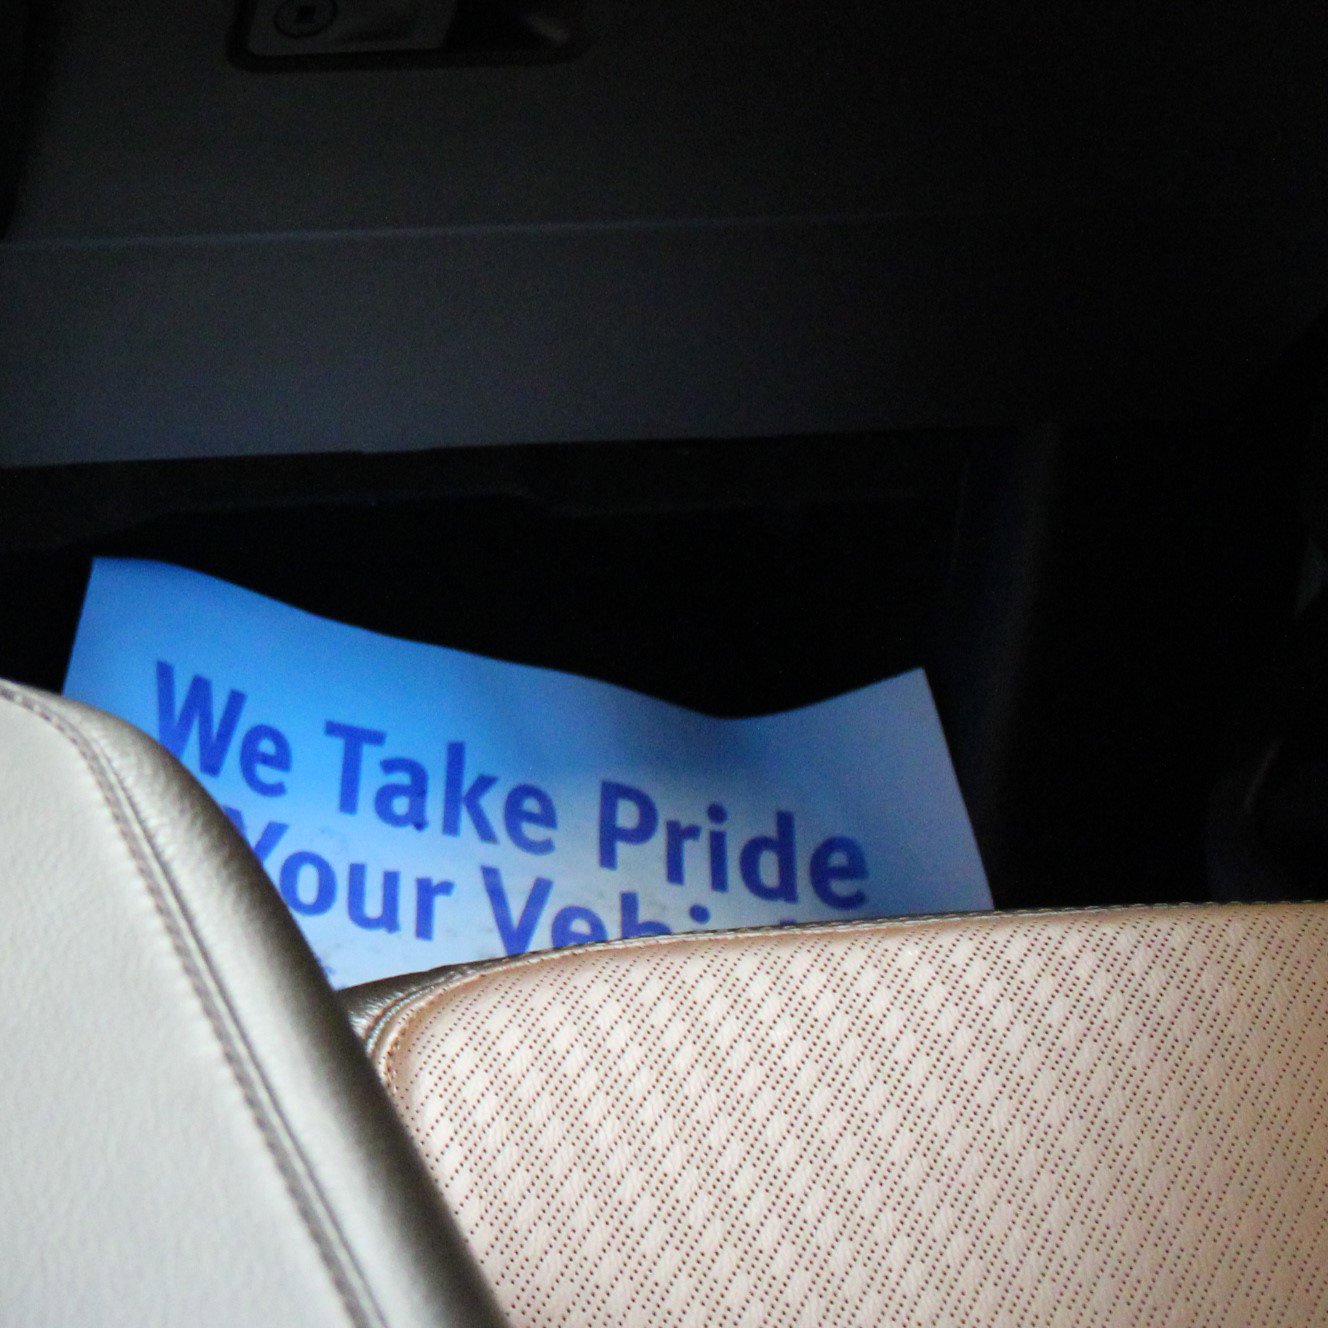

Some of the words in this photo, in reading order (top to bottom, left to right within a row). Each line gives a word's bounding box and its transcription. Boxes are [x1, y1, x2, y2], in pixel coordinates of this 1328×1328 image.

[154, 661, 293, 798] We
[324, 720, 558, 856] Take
[597, 780, 870, 910] Pride
